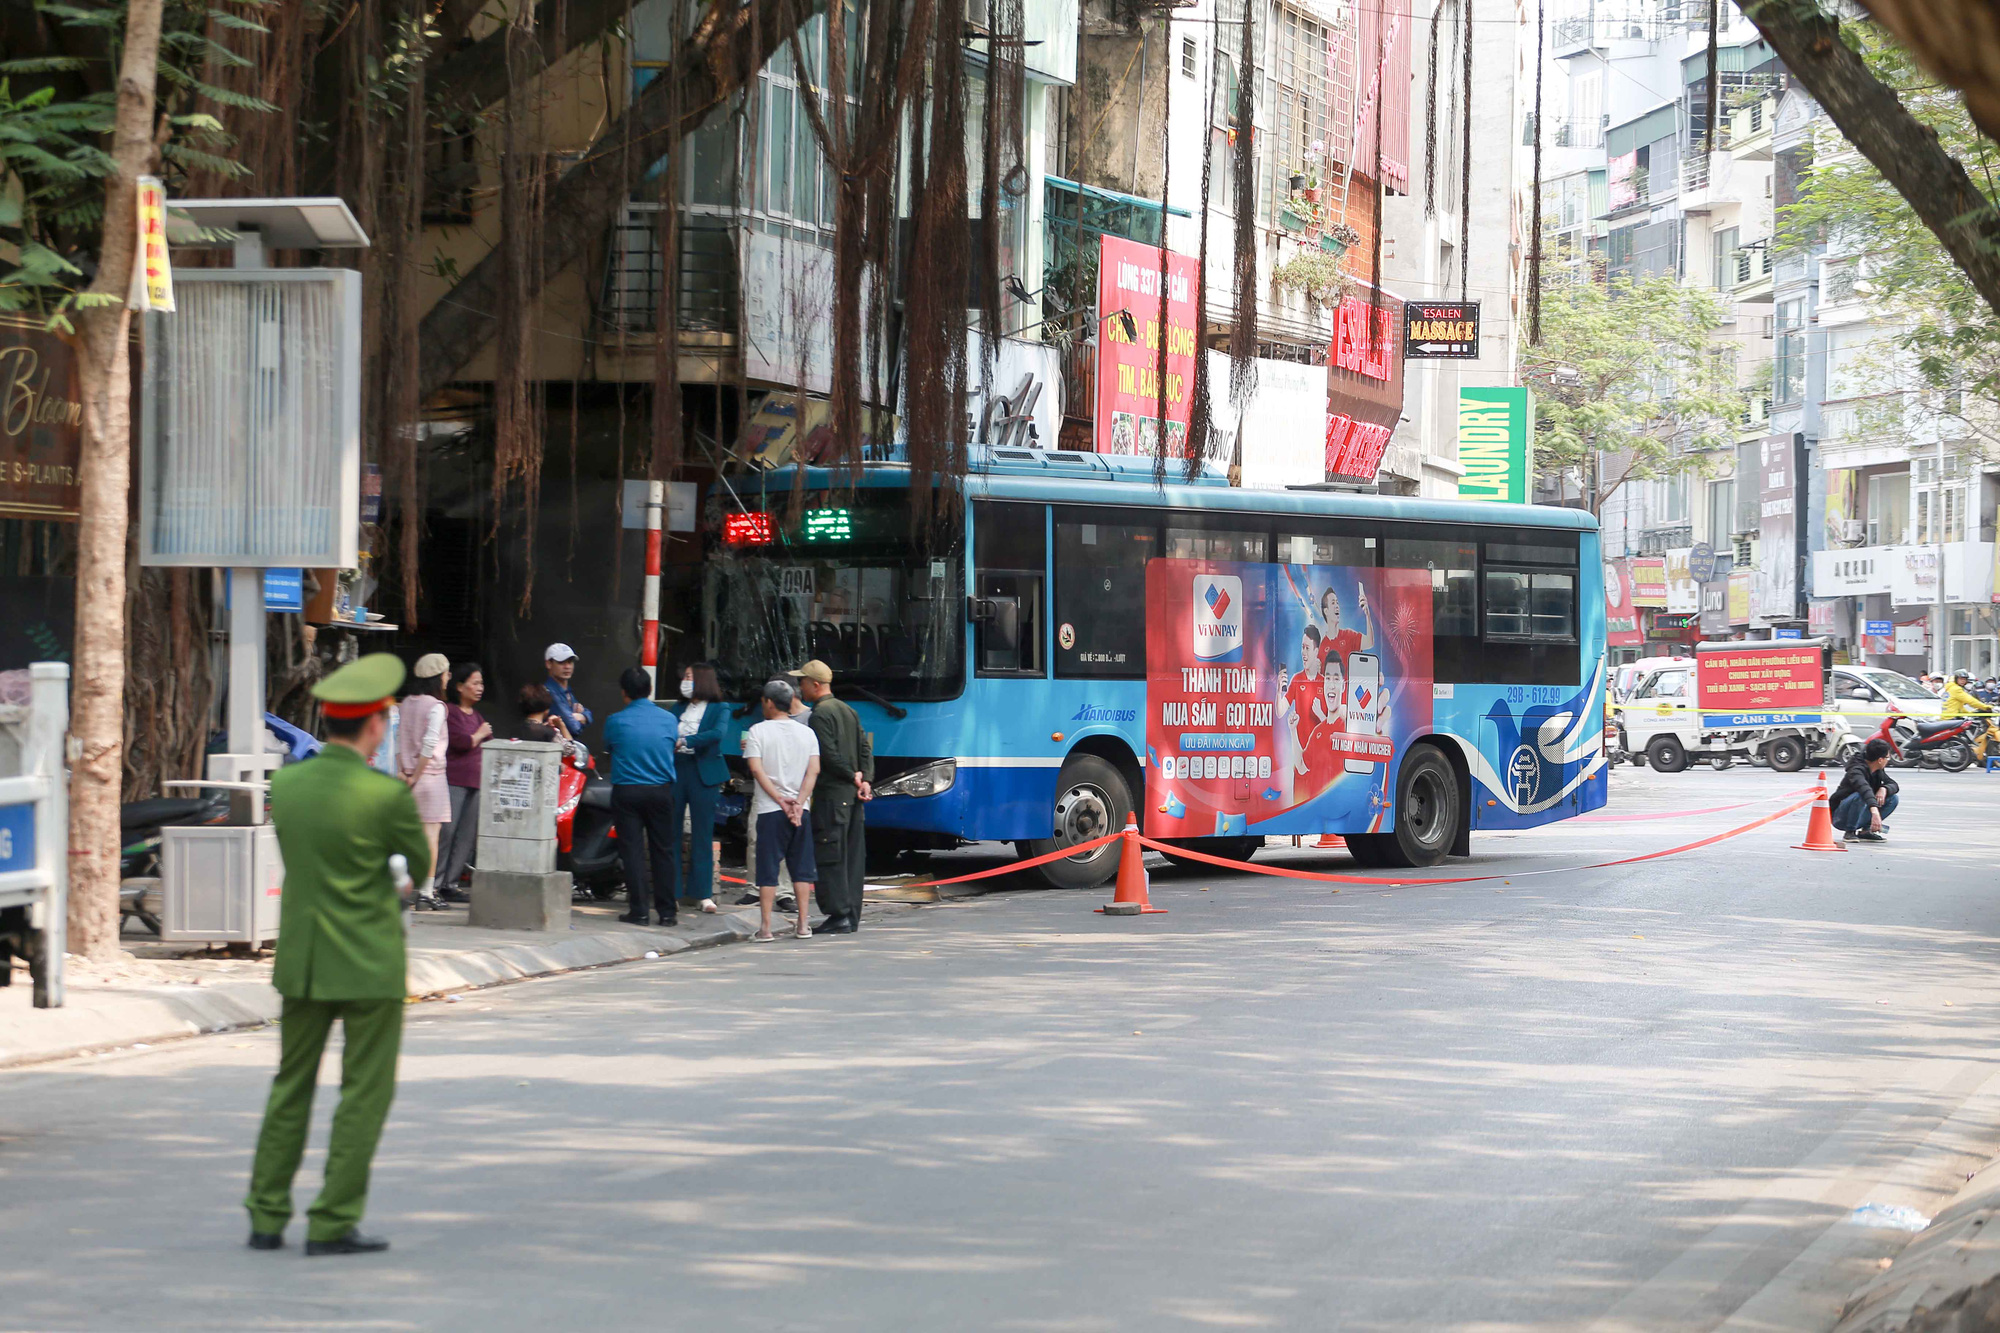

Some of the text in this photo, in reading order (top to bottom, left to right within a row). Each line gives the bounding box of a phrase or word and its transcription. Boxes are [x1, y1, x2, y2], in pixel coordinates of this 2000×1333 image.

[1117, 257, 1138, 292] LÒNG
[1140, 267, 1156, 296] 337
[1172, 268, 1188, 303] CẤN
[1424, 308, 1462, 320] ESALEN
[1167, 318, 1195, 358] LÒNG
[1409, 320, 1474, 342] MASSAGE
[0, 346, 84, 436] Bloom
[1118, 364, 1138, 402] TIM,
[1458, 398, 1510, 501] LAUNDRY
[1209, 624, 1238, 638] VNPAY
[1704, 658, 1718, 668] CÁN
[1730, 657, 1747, 667] NHÂN
[1181, 664, 1256, 694] THANH TOÁN
[1728, 671, 1749, 679] CHUNG
[1761, 669, 1773, 678] XÂY
[1507, 686, 1524, 703] 29B
[1532, 687, 1561, 704] 612.99
[1706, 683, 1718, 693] THỦ
[1728, 684, 1745, 692] XANH
[1750, 683, 1766, 693] SẠCH
[1784, 681, 1797, 690] VĂN
[1798, 681, 1814, 689] MINH
[1070, 704, 1136, 722] HANOIBUS
[1163, 702, 1188, 726] MUA
[1191, 696, 1216, 726] SẮM
[1226, 703, 1247, 731] GỌI
[1249, 702, 1272, 727] TAXI
[1356, 711, 1375, 722] VNPAY
[1185, 739, 1196, 749] ƯU
[1198, 738, 1211, 749] ĐÃI
[1229, 737, 1250, 749] NGÀY
[1340, 739, 1353, 752] NGAY
[1354, 740, 1368, 755] NHẬN
[1369, 742, 1392, 756] VOUCHER
